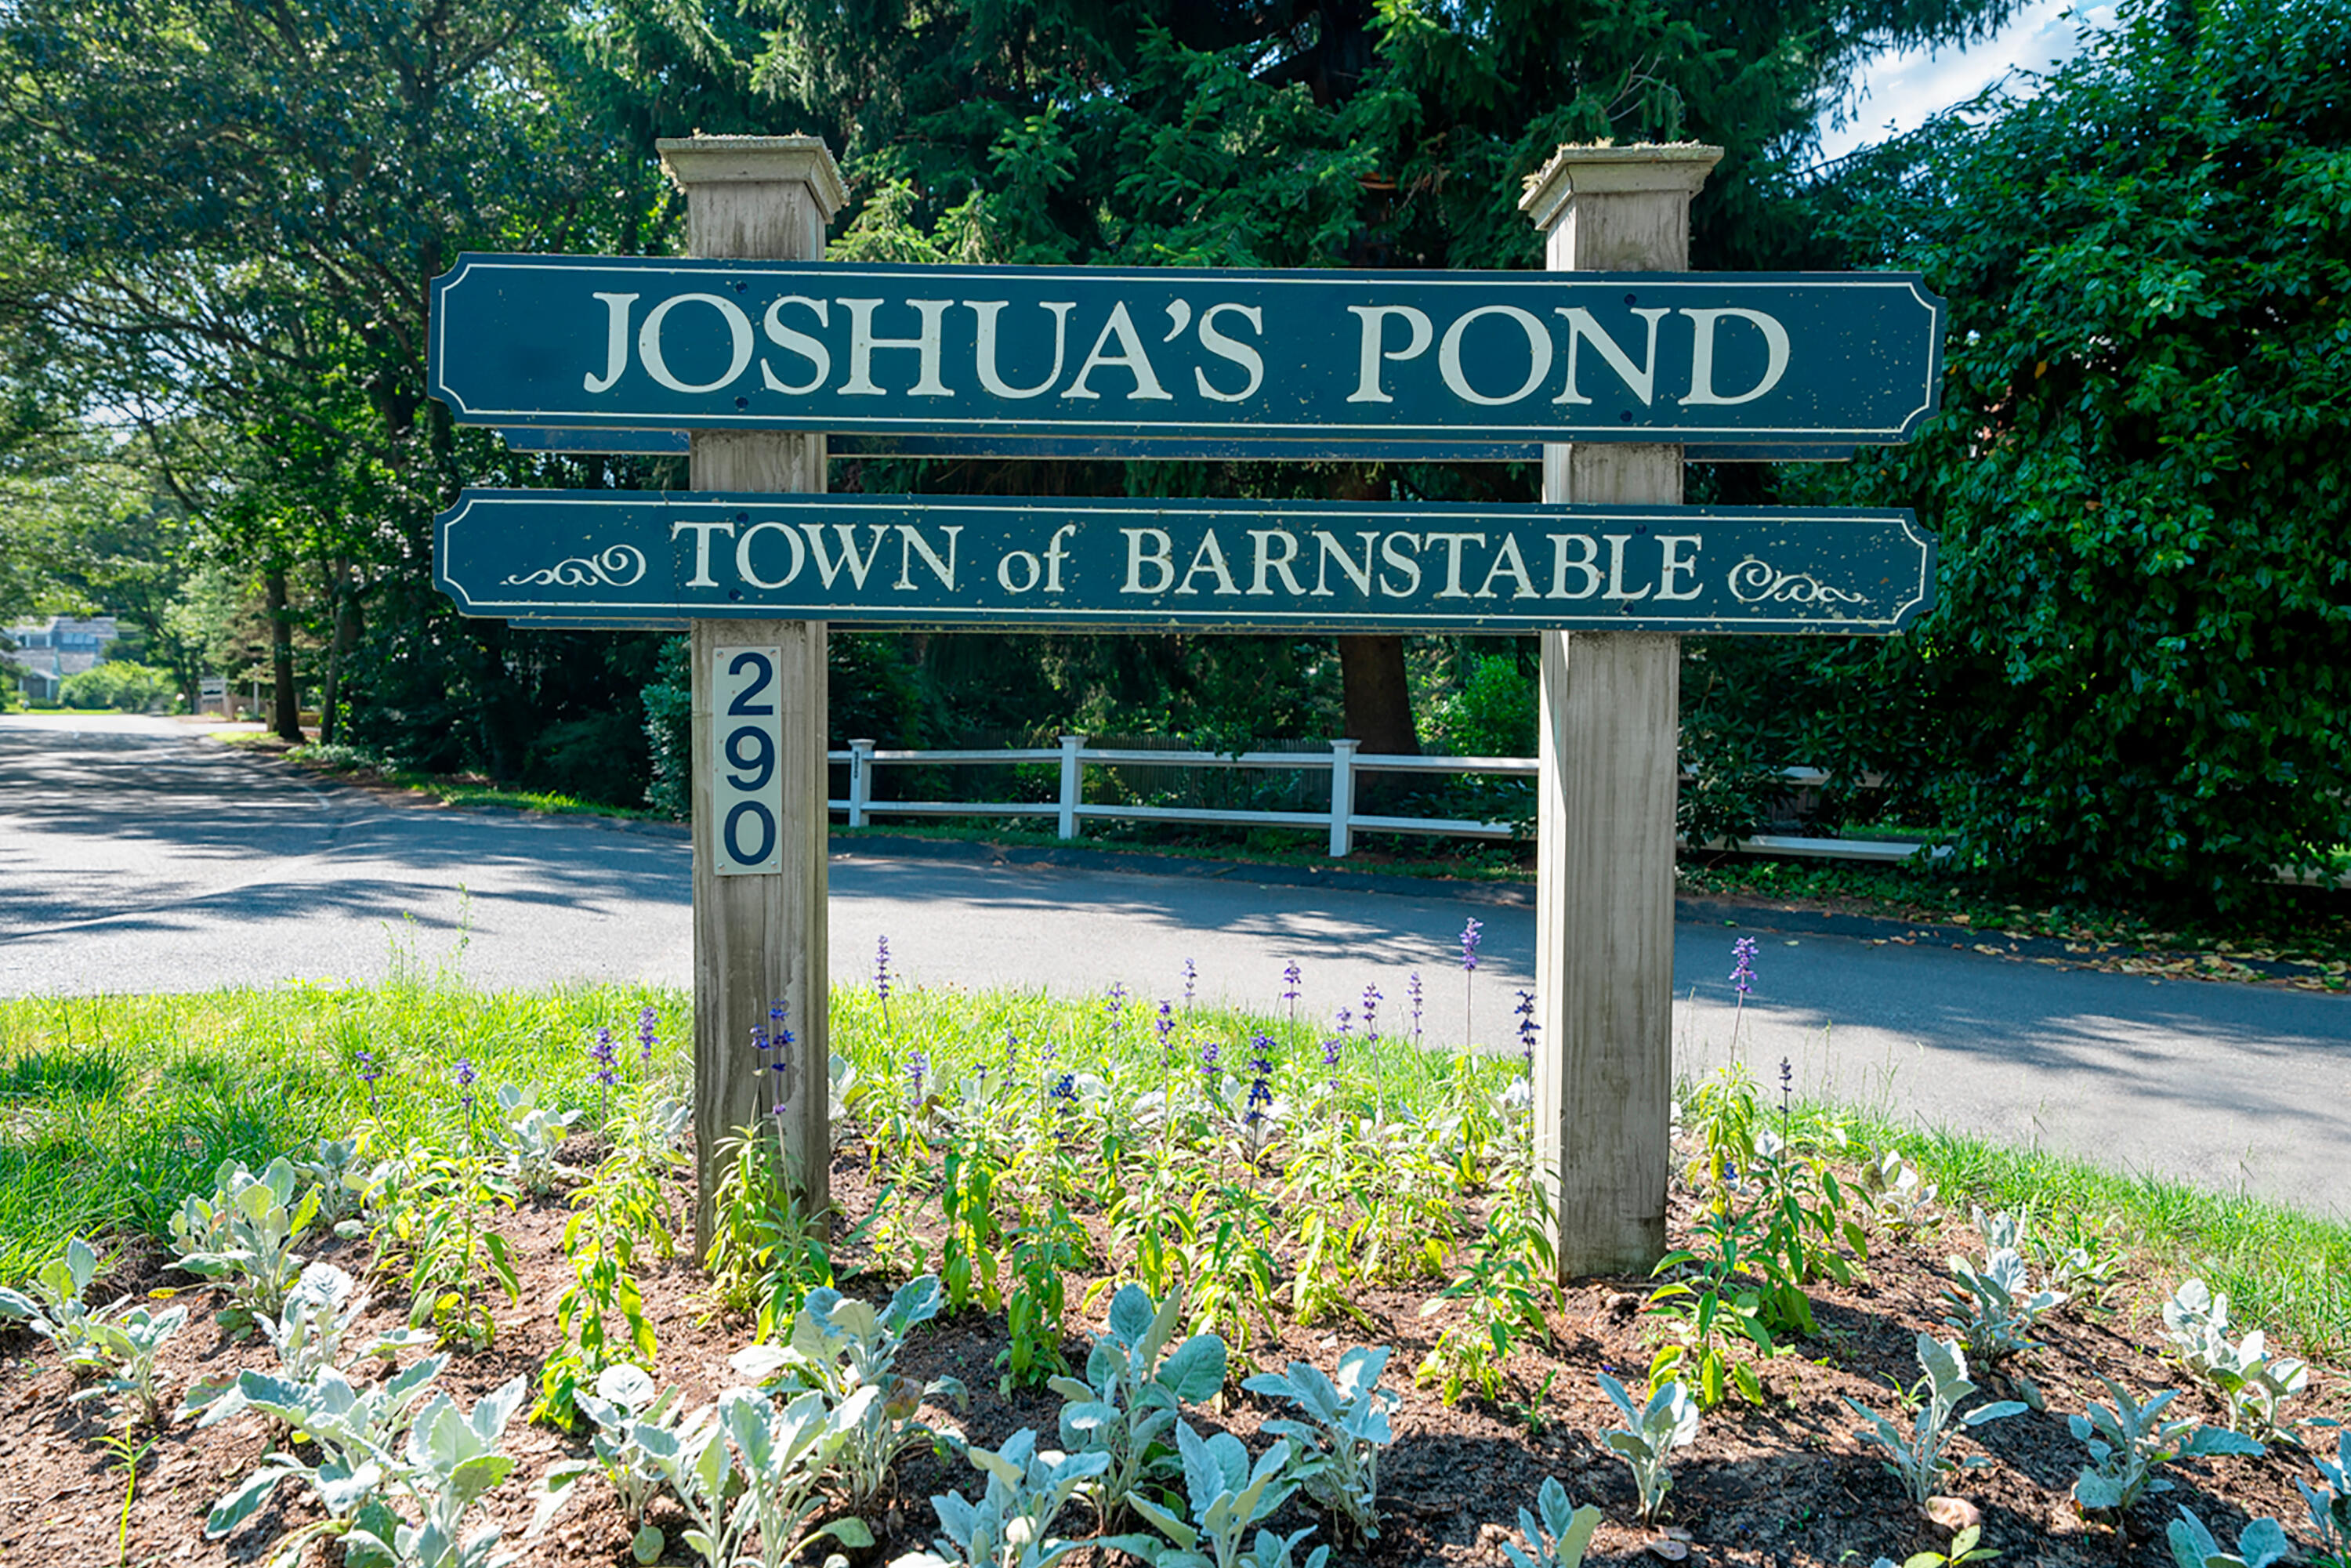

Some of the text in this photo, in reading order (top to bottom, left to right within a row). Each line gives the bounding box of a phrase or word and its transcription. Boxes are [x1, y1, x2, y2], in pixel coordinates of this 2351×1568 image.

[582, 292, 1790, 407] JOSHUA'S POND
[670, 520, 1704, 601] TOWN of BARNSTABLE
[723, 651, 777, 867] 290
